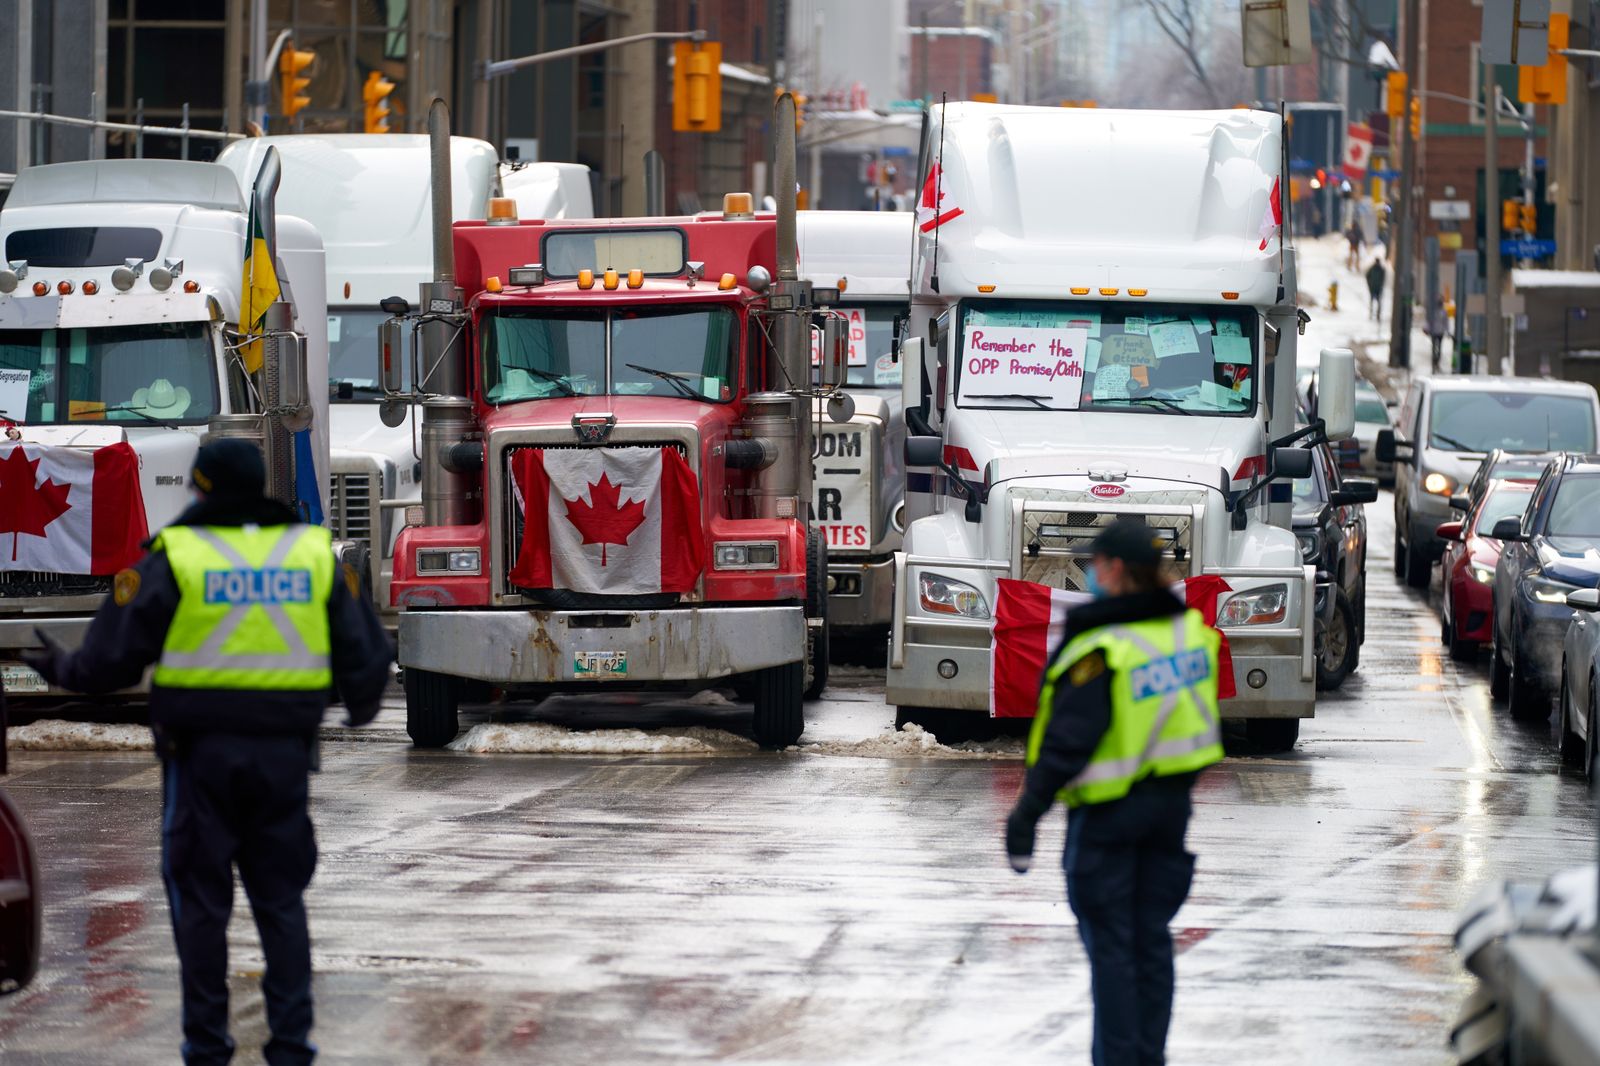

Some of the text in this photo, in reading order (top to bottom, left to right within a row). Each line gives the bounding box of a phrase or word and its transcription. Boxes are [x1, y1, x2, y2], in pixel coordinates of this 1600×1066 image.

[971, 331, 1073, 357] Remember the
[968, 358, 1082, 382] OPP Promise/Oath
[206, 571, 309, 601] POLICE
[576, 658, 624, 671] CJF 625
